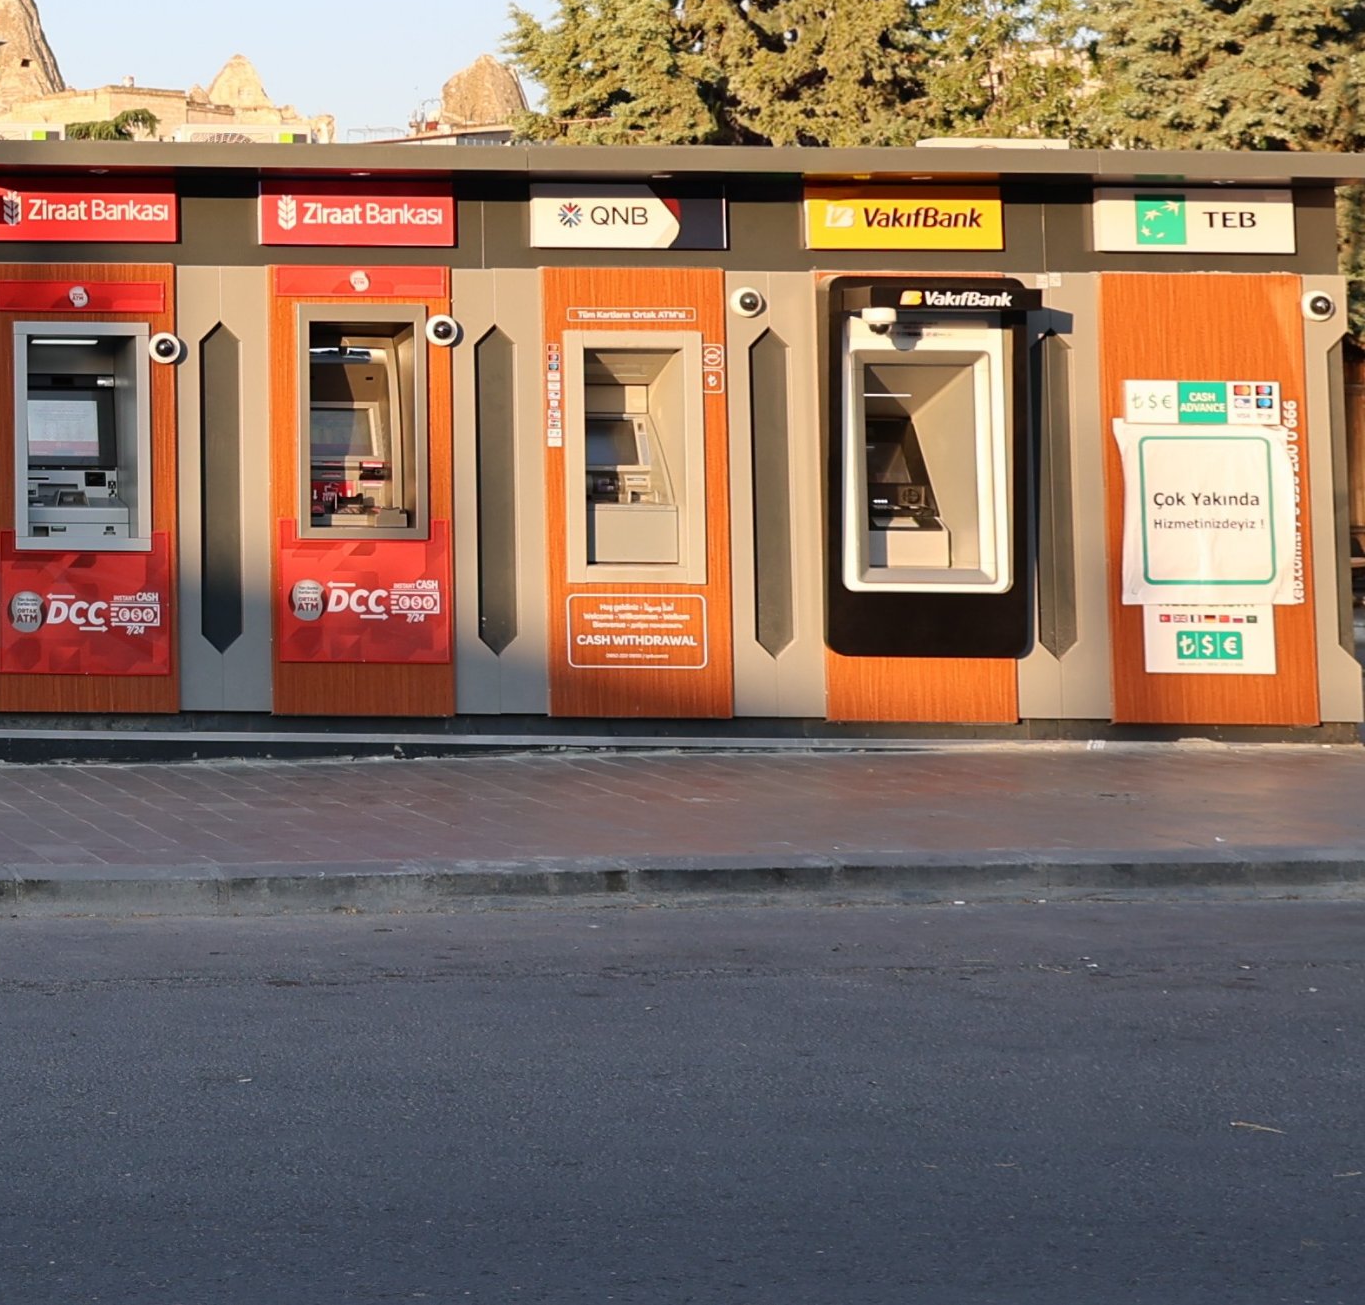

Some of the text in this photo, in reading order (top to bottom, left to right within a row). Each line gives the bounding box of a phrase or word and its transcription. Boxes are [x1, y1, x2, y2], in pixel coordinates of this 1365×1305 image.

[28, 199, 168, 221] Ziraat Bankası
[302, 203, 443, 225] Ziraat Bankası
[590, 206, 649, 226] QNB
[864, 207, 983, 228] VakıfBank
[1202, 211, 1257, 228] TEB
[925, 291, 1012, 307] VakıfBank
[1189, 392, 1216, 402] CASH
[1180, 403, 1226, 413] ADVANCE
[1283, 400, 1297, 427] 666
[1153, 492, 1260, 509] Çok Yakında
[1154, 519, 1256, 531] Hizmetinizdeyiz
[416, 580, 438, 590] CASH
[136, 592, 158, 602] CASH
[327, 588, 388, 613] DCC
[46, 601, 108, 624] DCC
[297, 602, 319, 611] ATM
[16, 614, 38, 623] ATM
[406, 614, 425, 623] 7/24
[126, 625, 145, 635] 7/24
[576, 634, 698, 646] CASH WITHDRAWAL
